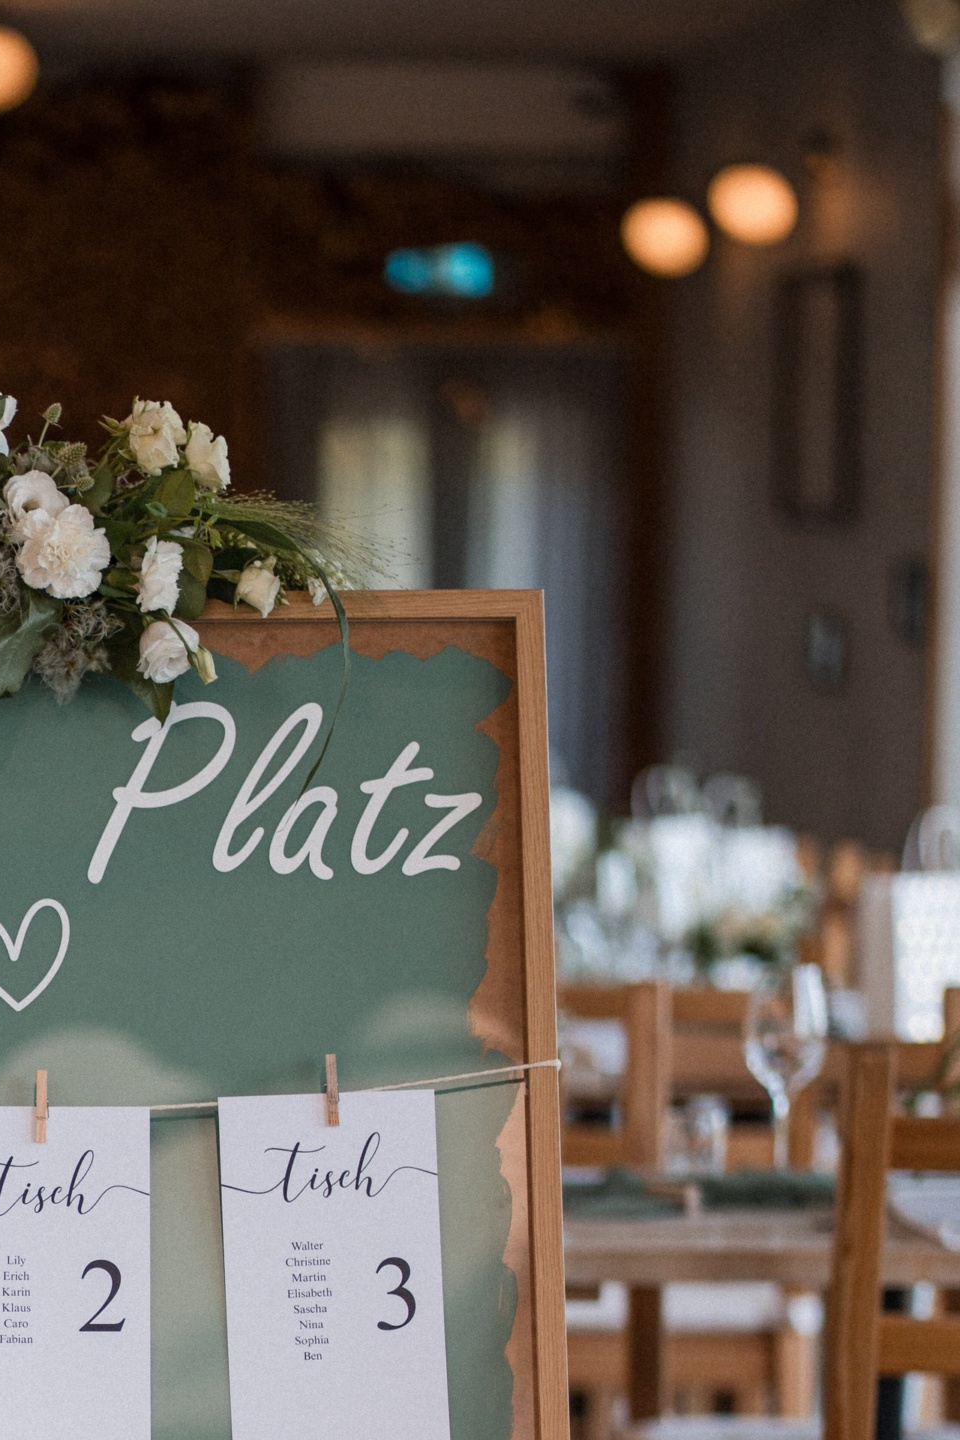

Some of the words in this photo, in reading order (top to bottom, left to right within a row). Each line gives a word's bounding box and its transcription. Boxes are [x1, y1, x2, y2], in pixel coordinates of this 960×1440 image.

[85, 699, 483, 885] Platz
[291, 1241, 324, 1251] Walter
[7, 1255, 26, 1267] Lily
[285, 1256, 331, 1267] Christine
[3, 1271, 30, 1281] Erich
[291, 1273, 327, 1283] Martin
[2, 1287, 31, 1297] Karin
[79, 1260, 125, 1332] 2
[287, 1287, 333, 1299] Elisabeth
[376, 1257, 416, 1330] 3
[2, 1302, 31, 1313] Klaus
[293, 1303, 328, 1314] Sascha
[3, 1318, 29, 1328] Caro
[299, 1319, 324, 1330] Nina
[0, 1334, 33, 1344] Fabian
[294, 1335, 330, 1348] Sophia
[303, 1351, 323, 1361] Ben
